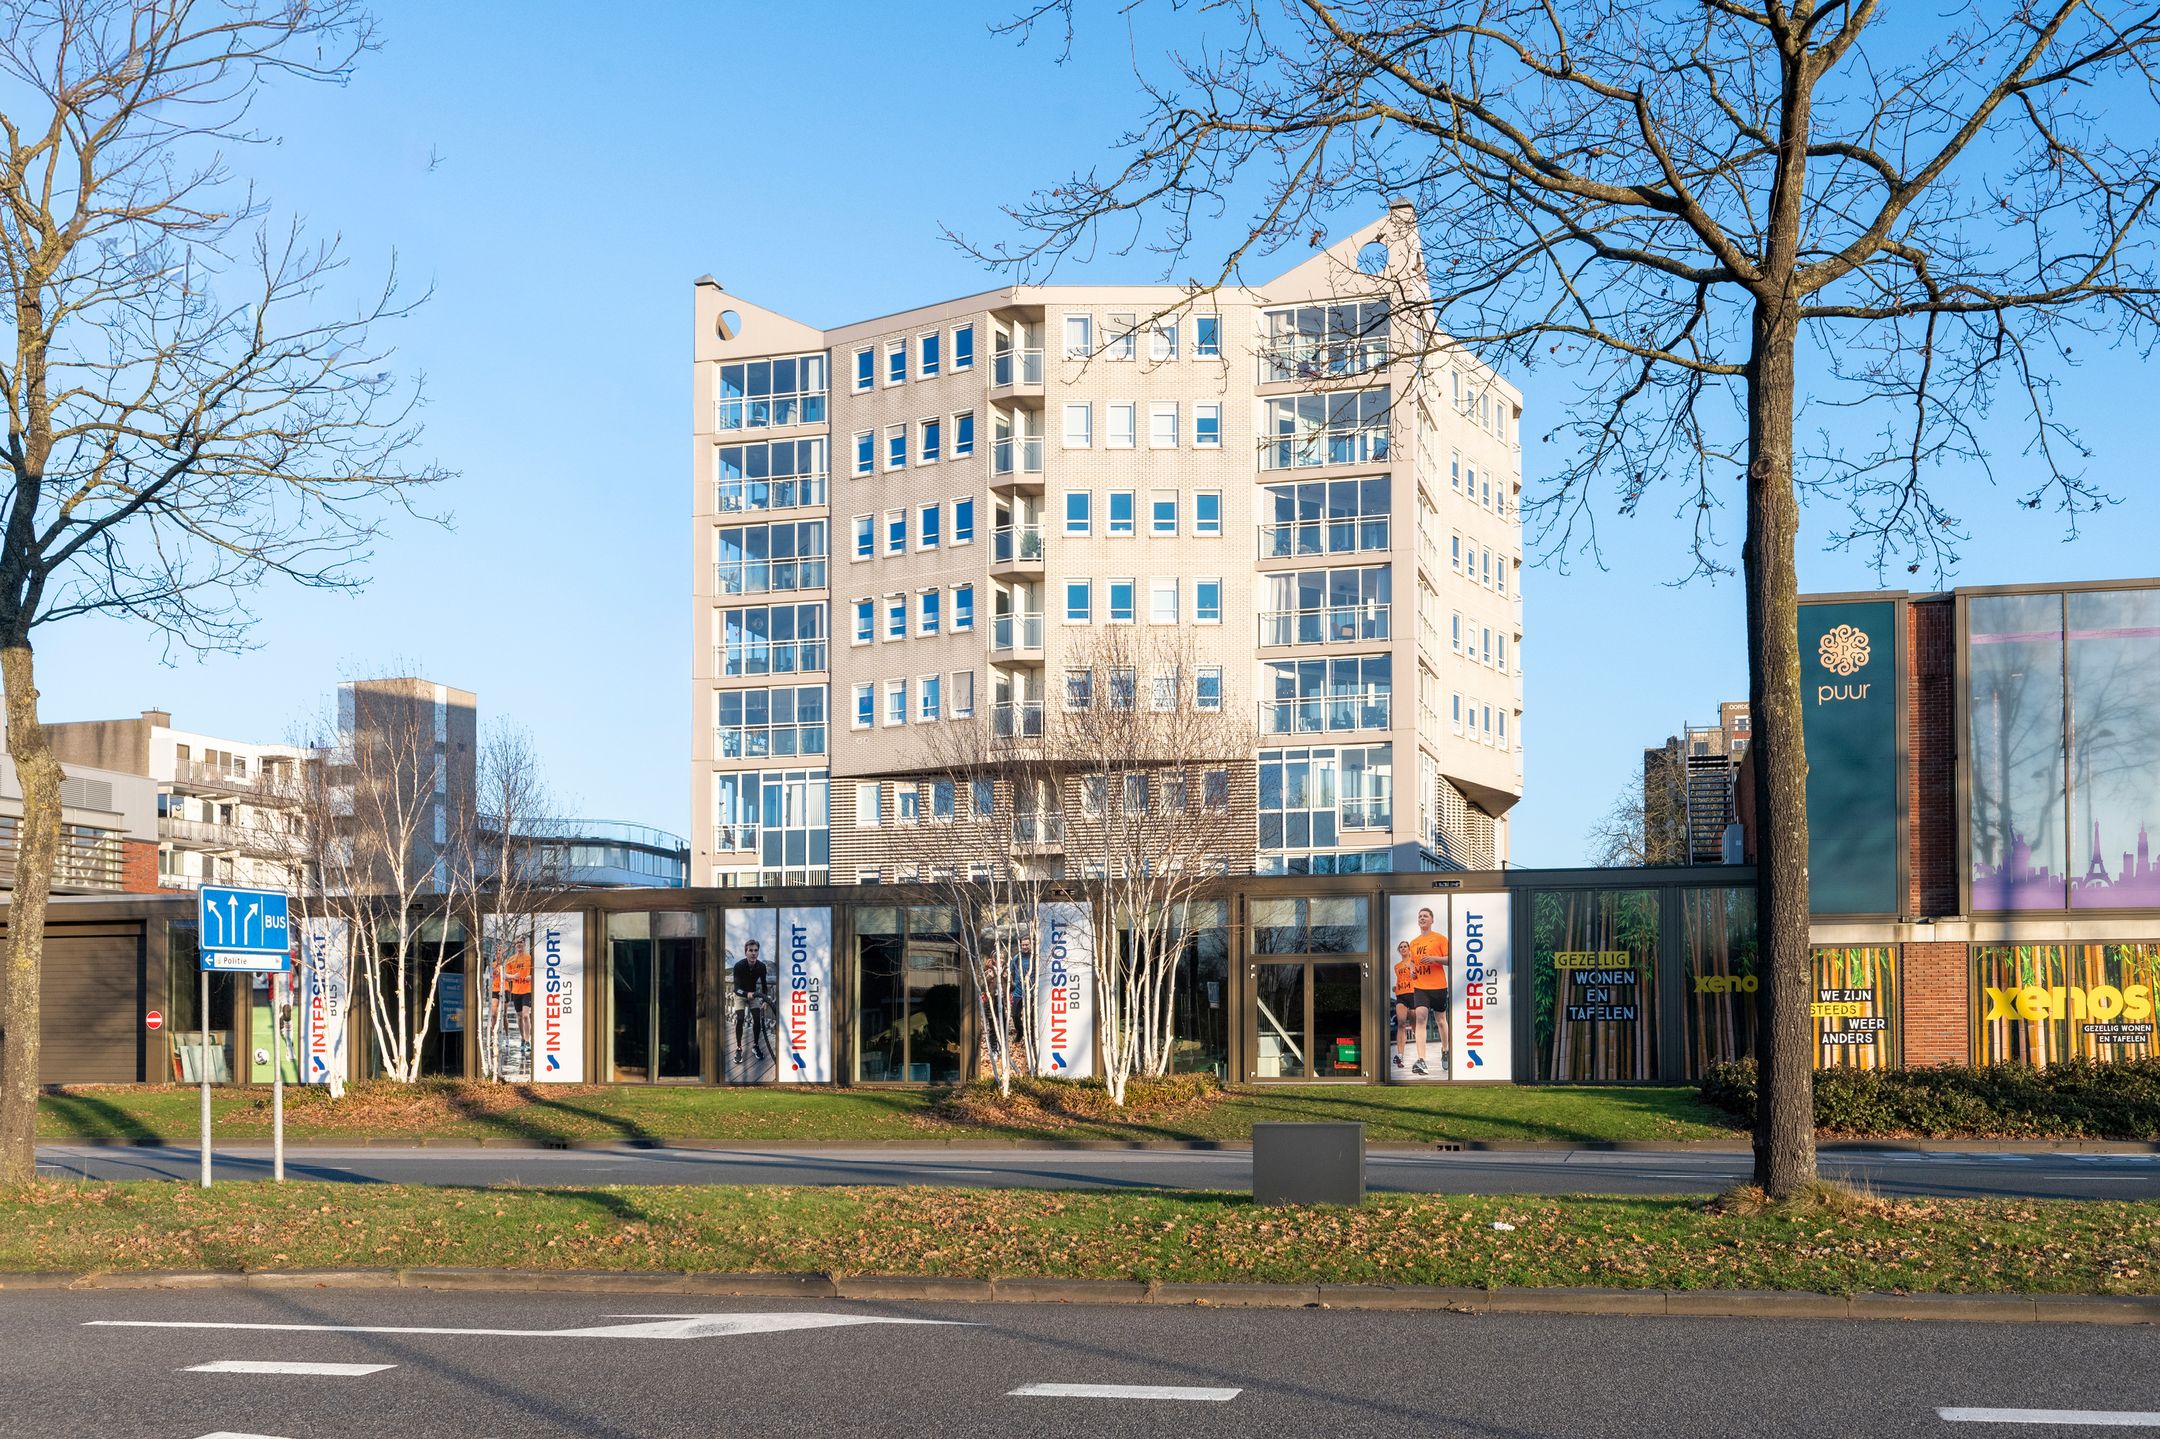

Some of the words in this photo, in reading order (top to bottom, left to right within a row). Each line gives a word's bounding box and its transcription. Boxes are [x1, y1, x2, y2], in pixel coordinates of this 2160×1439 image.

[1818, 684, 1871, 706] puur
[264, 914, 287, 929] BUS
[1416, 945, 1428, 955] WE
[223, 956, 248, 965] Politie
[1558, 953, 1626, 966] GEZELLIG
[1051, 919, 1068, 1049] INTERSPORT
[1466, 911, 1484, 1046] INTERSPORT
[1575, 971, 1635, 984] WONEN
[312, 933, 327, 1053] INTERSPORT
[546, 929, 561, 1051] INTERSPORT
[792, 924, 807, 1050] INTERSPORT
[1069, 974, 1080, 1010] BOLS
[1486, 968, 1498, 1006] BOLS
[562, 981, 573, 1014] BOLS
[809, 977, 819, 1012] BOLS
[1586, 988, 1608, 1002] EN
[1821, 990, 1840, 1001] WE
[1844, 990, 1872, 1001] ZIJN
[1810, 1004, 1857, 1015] STEEDS
[1984, 984, 2151, 1021] xenos
[1569, 1006, 1634, 1020] TAFELEN
[1848, 1018, 1885, 1030] WEER
[2084, 1024, 2119, 1032] GEZELLIG
[2121, 1024, 2152, 1032] WONEN
[1822, 1033, 1873, 1044] ANDERS
[2099, 1035, 2110, 1043] EN
[2112, 1035, 2146, 1043] TAFELEN
